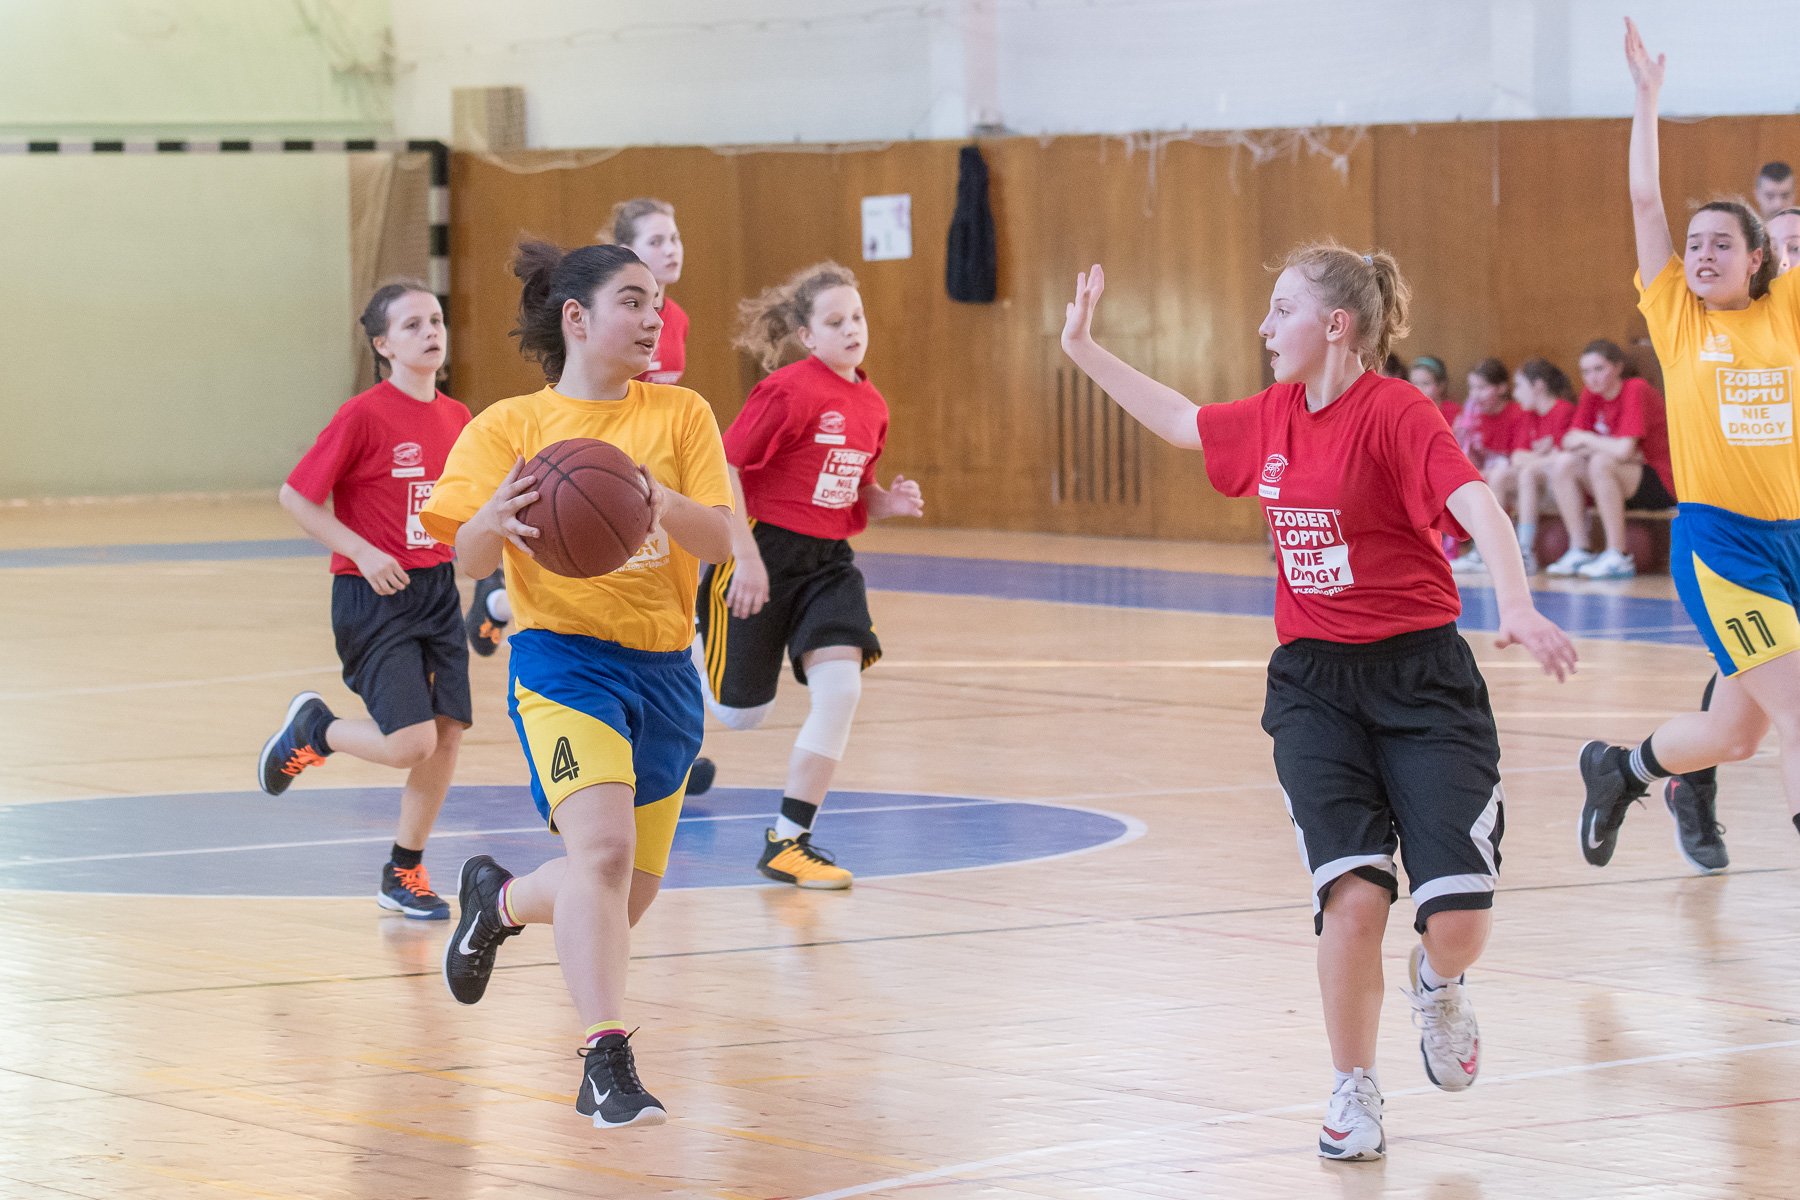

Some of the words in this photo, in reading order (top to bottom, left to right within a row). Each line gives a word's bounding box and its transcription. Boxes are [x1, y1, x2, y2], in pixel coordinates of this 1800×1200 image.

[1723, 371, 1784, 387] ZOBER
[1725, 387, 1784, 403] LOPTU
[1742, 407, 1770, 420] NIE
[1728, 421, 1786, 435] DROGY
[1272, 511, 1331, 528] ZOBER
[1276, 529, 1335, 547] LOPTU
[1292, 551, 1325, 567] NIE
[1725, 609, 1777, 657] 11
[551, 736, 580, 783] 4
